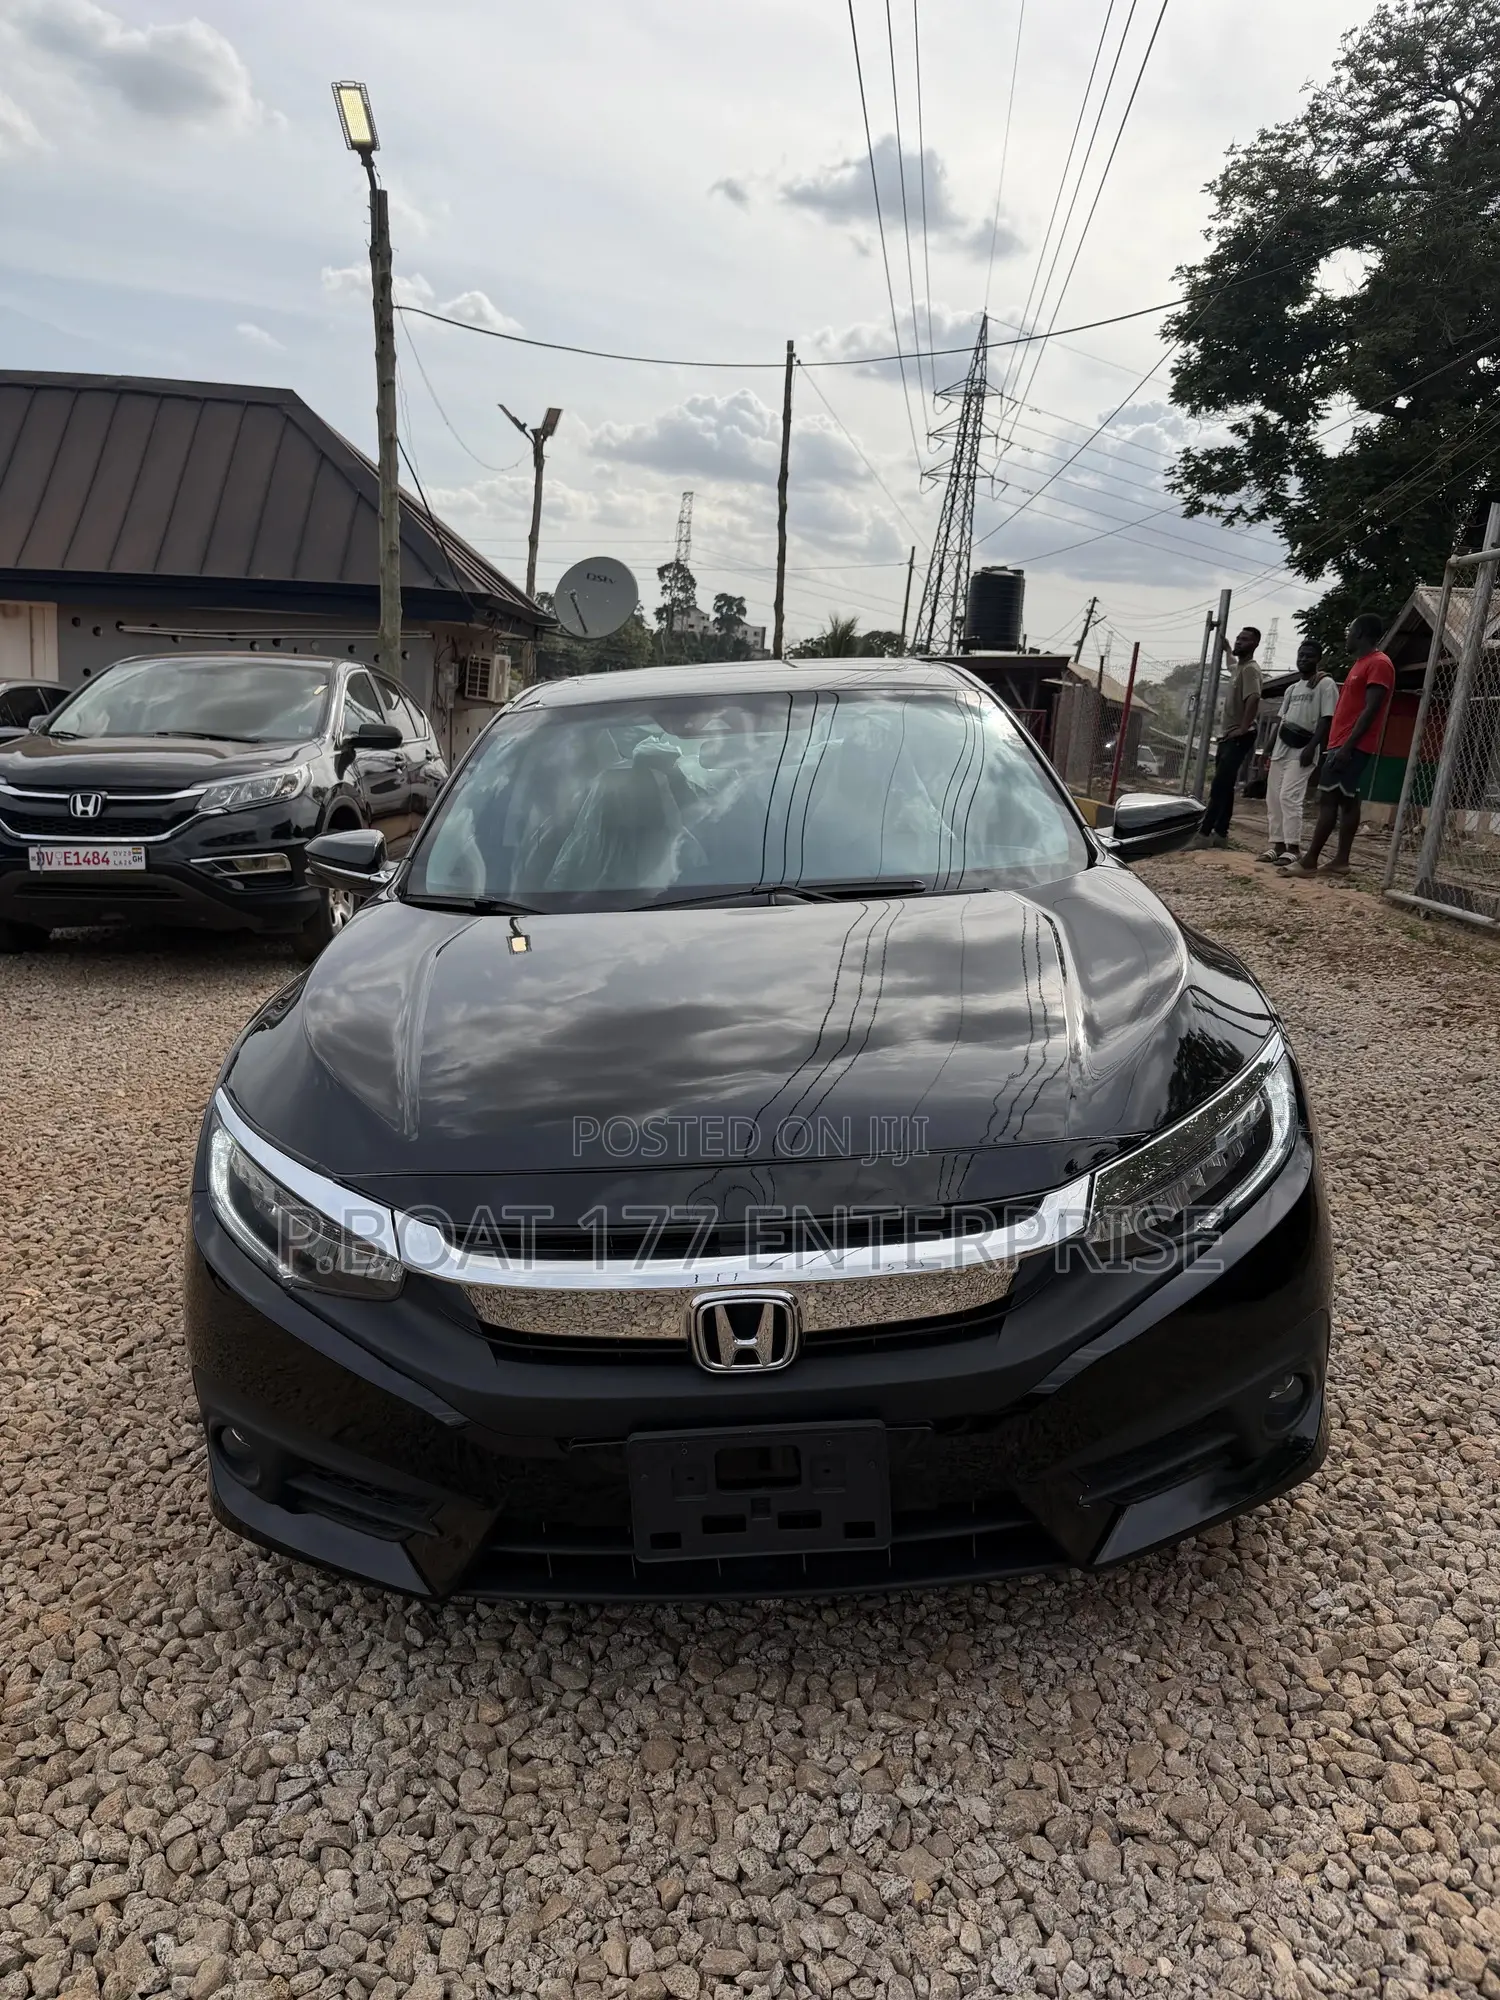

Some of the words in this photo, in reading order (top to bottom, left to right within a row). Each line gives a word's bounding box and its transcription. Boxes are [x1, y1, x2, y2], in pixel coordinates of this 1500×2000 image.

[36, 851, 54, 866] DV
[64, 851, 110, 866] E1484
[132, 855, 143, 863] GH
